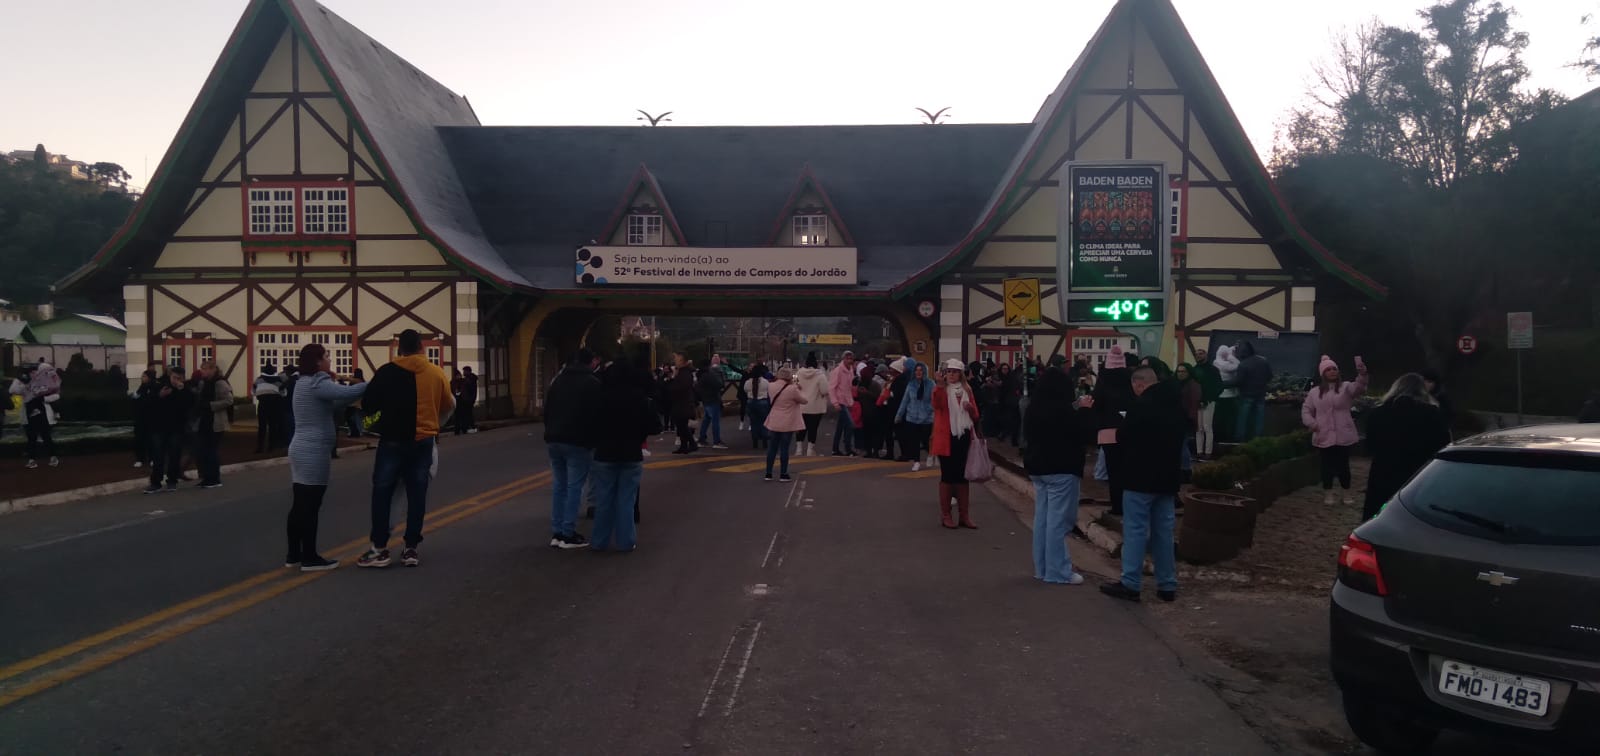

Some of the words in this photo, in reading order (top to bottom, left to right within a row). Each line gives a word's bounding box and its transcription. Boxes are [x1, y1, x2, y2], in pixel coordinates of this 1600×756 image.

[1080, 176, 1114, 186] BADEN
[1117, 176, 1152, 184] BADEN
[614, 254, 637, 264] Seja
[640, 254, 712, 264] bem-vindo(a)
[634, 267, 676, 276] Festival
[678, 268, 690, 276] de
[694, 268, 732, 276] Inverno
[734, 268, 746, 276] de
[749, 268, 792, 278] Campos
[794, 268, 808, 276] do
[810, 268, 847, 277] Jordão
